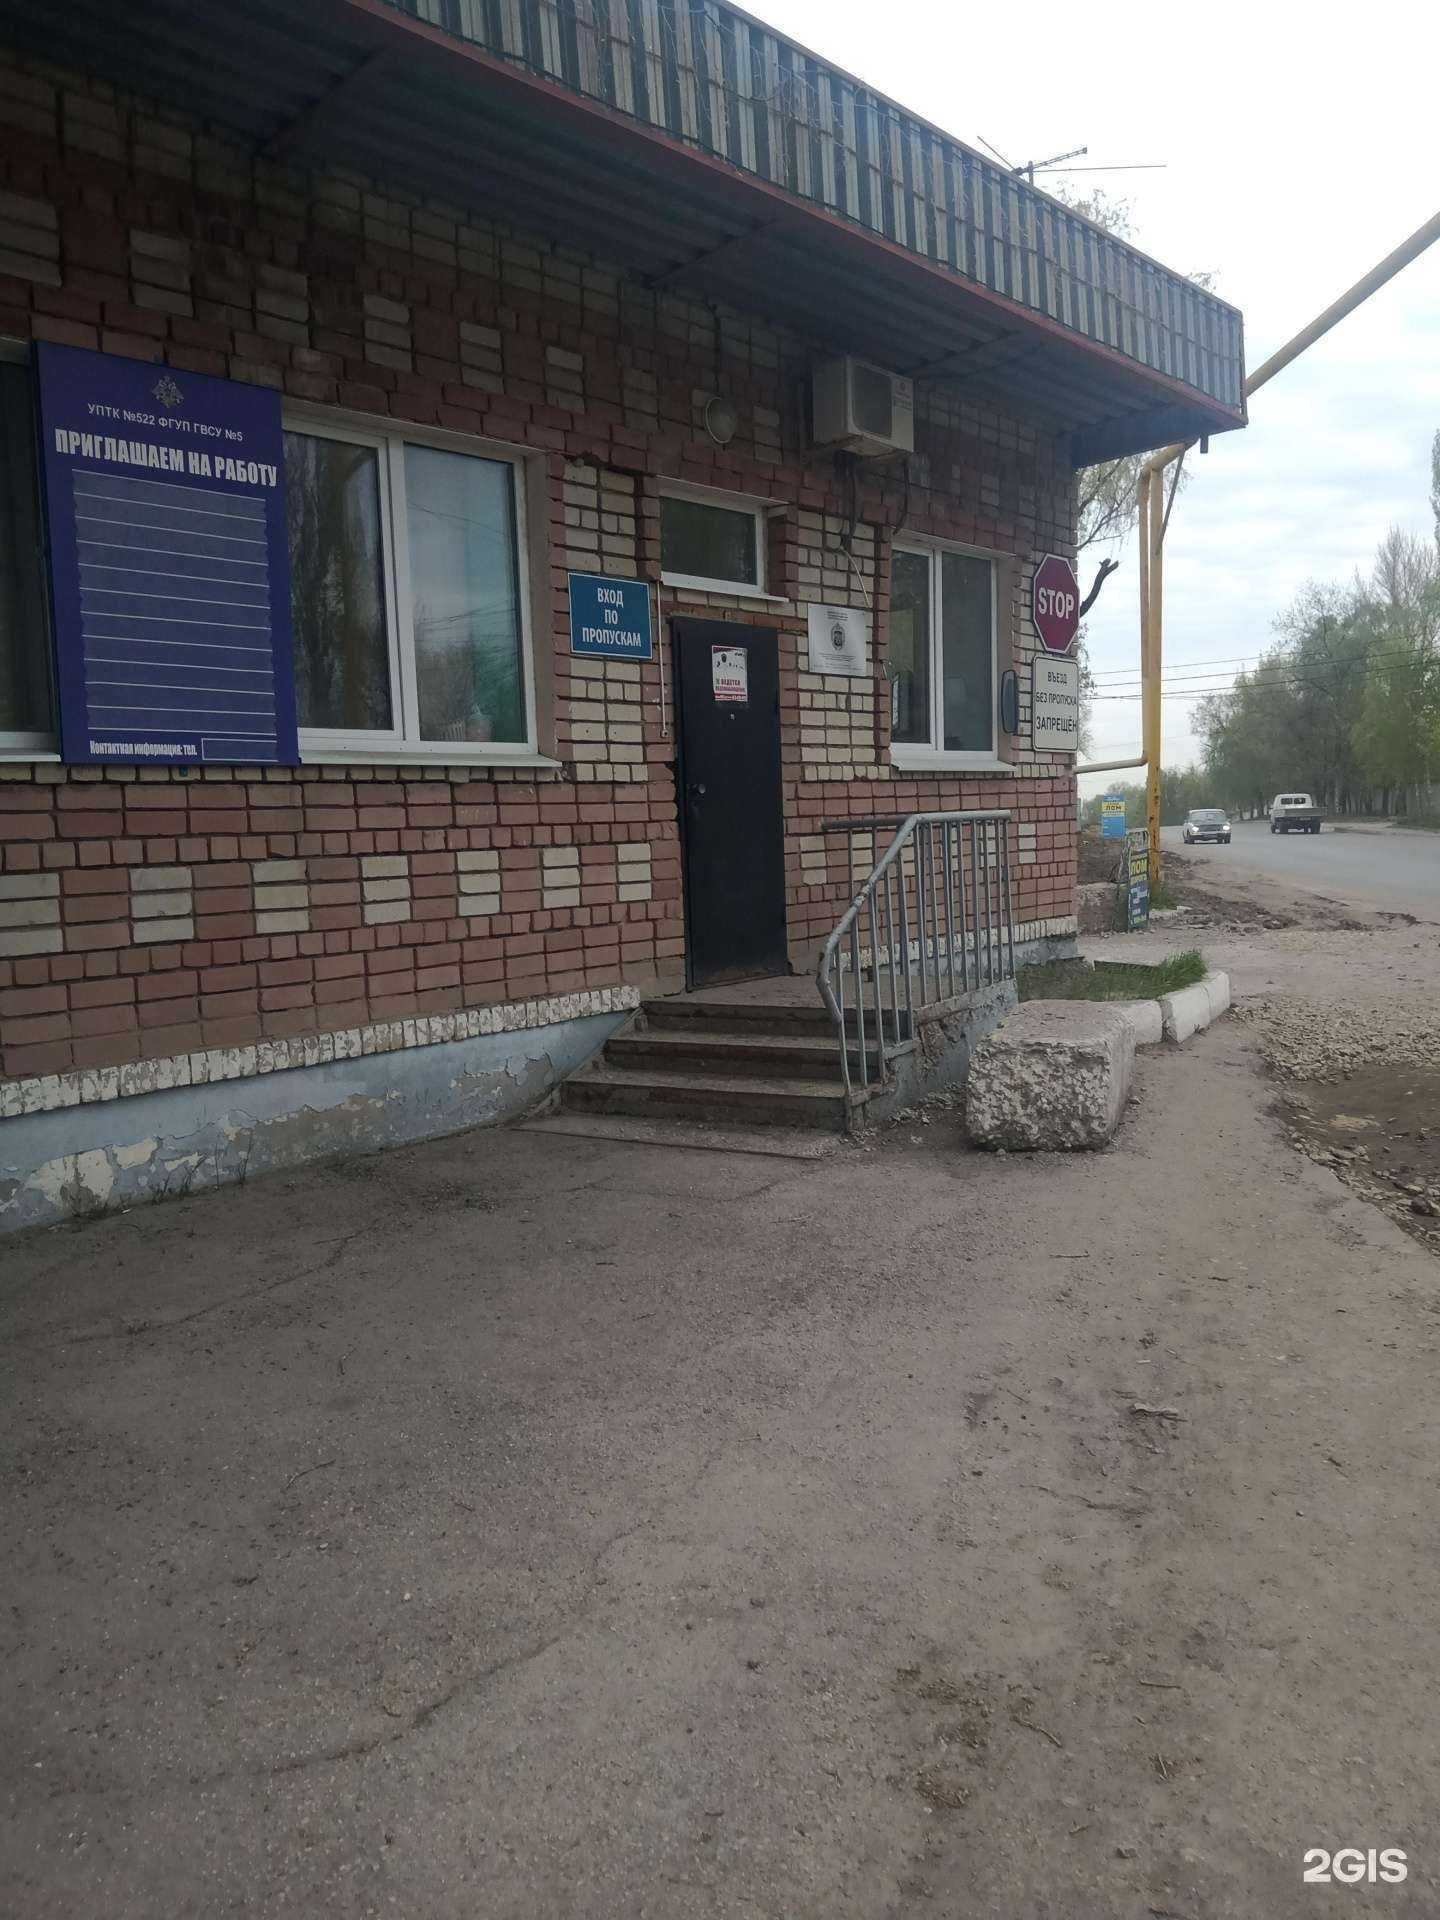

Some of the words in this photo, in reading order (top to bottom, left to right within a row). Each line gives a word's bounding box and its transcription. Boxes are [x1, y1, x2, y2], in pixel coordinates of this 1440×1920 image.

[87, 403, 120, 419] УПТК
[123, 410, 155, 425] №522
[158, 416, 191, 433] ФГУП
[193, 423, 222, 439] ГВСУ
[225, 429, 243, 442] №5
[54, 428, 185, 473] ПРИГЛАШАЕМ
[188, 451, 212, 478] НА
[215, 457, 277, 488] РАБОТУ
[597, 588, 624, 608] ВХОД
[1038, 587, 1075, 620] STOP
[604, 609, 618, 625] ПО
[582, 627, 642, 647] ПРОПУСКАМ
[1047, 671, 1067, 686] ВЪЕЗД
[1035, 691, 1047, 703] БЕЗ
[1048, 692, 1077, 706] ПРОПУСКА
[89, 740, 134, 755] Контактная
[134, 742, 182, 757] информация:
[182, 744, 198, 756] тел.
